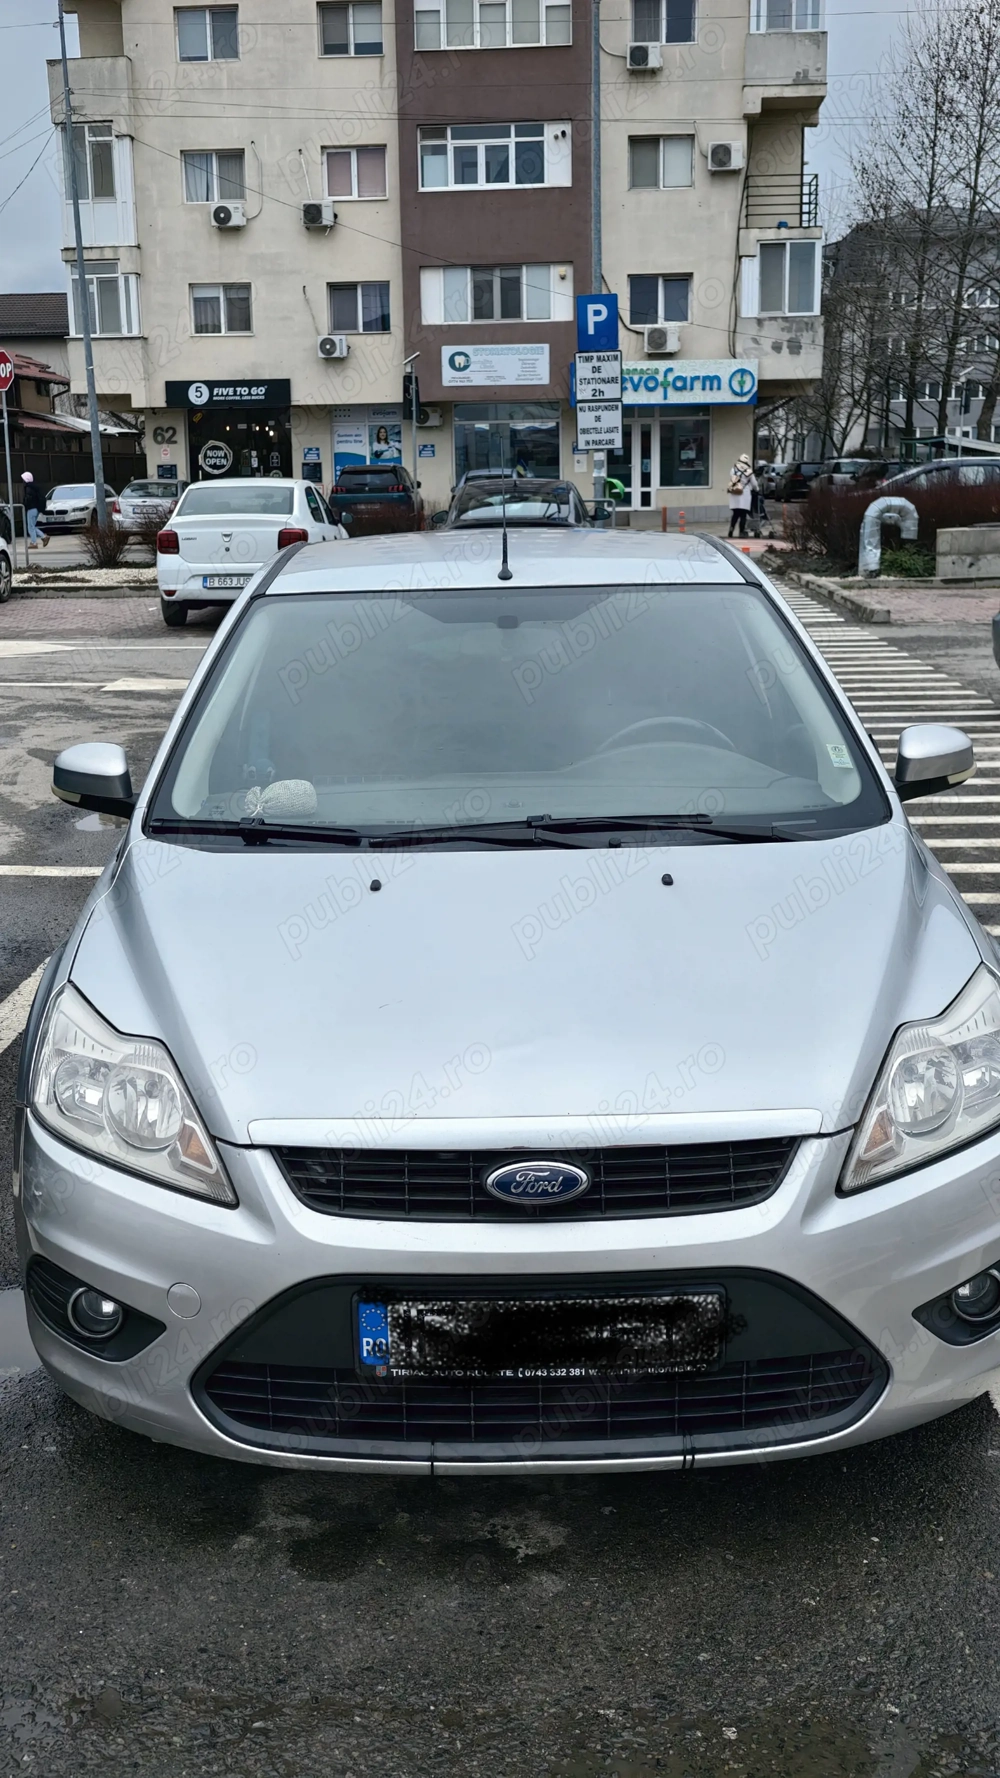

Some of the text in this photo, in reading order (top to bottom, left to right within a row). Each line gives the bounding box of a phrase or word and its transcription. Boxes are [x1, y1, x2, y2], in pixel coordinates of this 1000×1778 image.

[587, 304, 608, 335] P
[472, 346, 544, 356] STOMATOLOGIE
[578, 354, 618, 363] TIMP MAXIM
[0, 363, 12, 378] OP
[591, 366, 602, 374] DE
[622, 367, 660, 376] RMACIA
[578, 376, 619, 386] STATIONARE
[194, 385, 204, 399] 5
[213, 386, 266, 396] FIVE TO GO
[591, 388, 605, 398] 2h
[578, 404, 619, 413] NU RASPUNDEM
[594, 415, 602, 423] DE
[579, 426, 619, 435] OBIECTELE LASATE
[153, 427, 177, 445] 62
[591, 438, 615, 446] PARCARE
[206, 450, 225, 458] NOW
[205, 457, 227, 466] OPEN
[208, 577, 215, 586] B
[217, 577, 234, 586] 663
[510, 1170, 564, 1194] Ford
[362, 1337, 387, 1357] RO
[431, 1369, 464, 1377] AUTO
[524, 1368, 548, 1377] 0743
[549, 1368, 567, 1376] 332
[569, 1368, 585, 1376] 381
